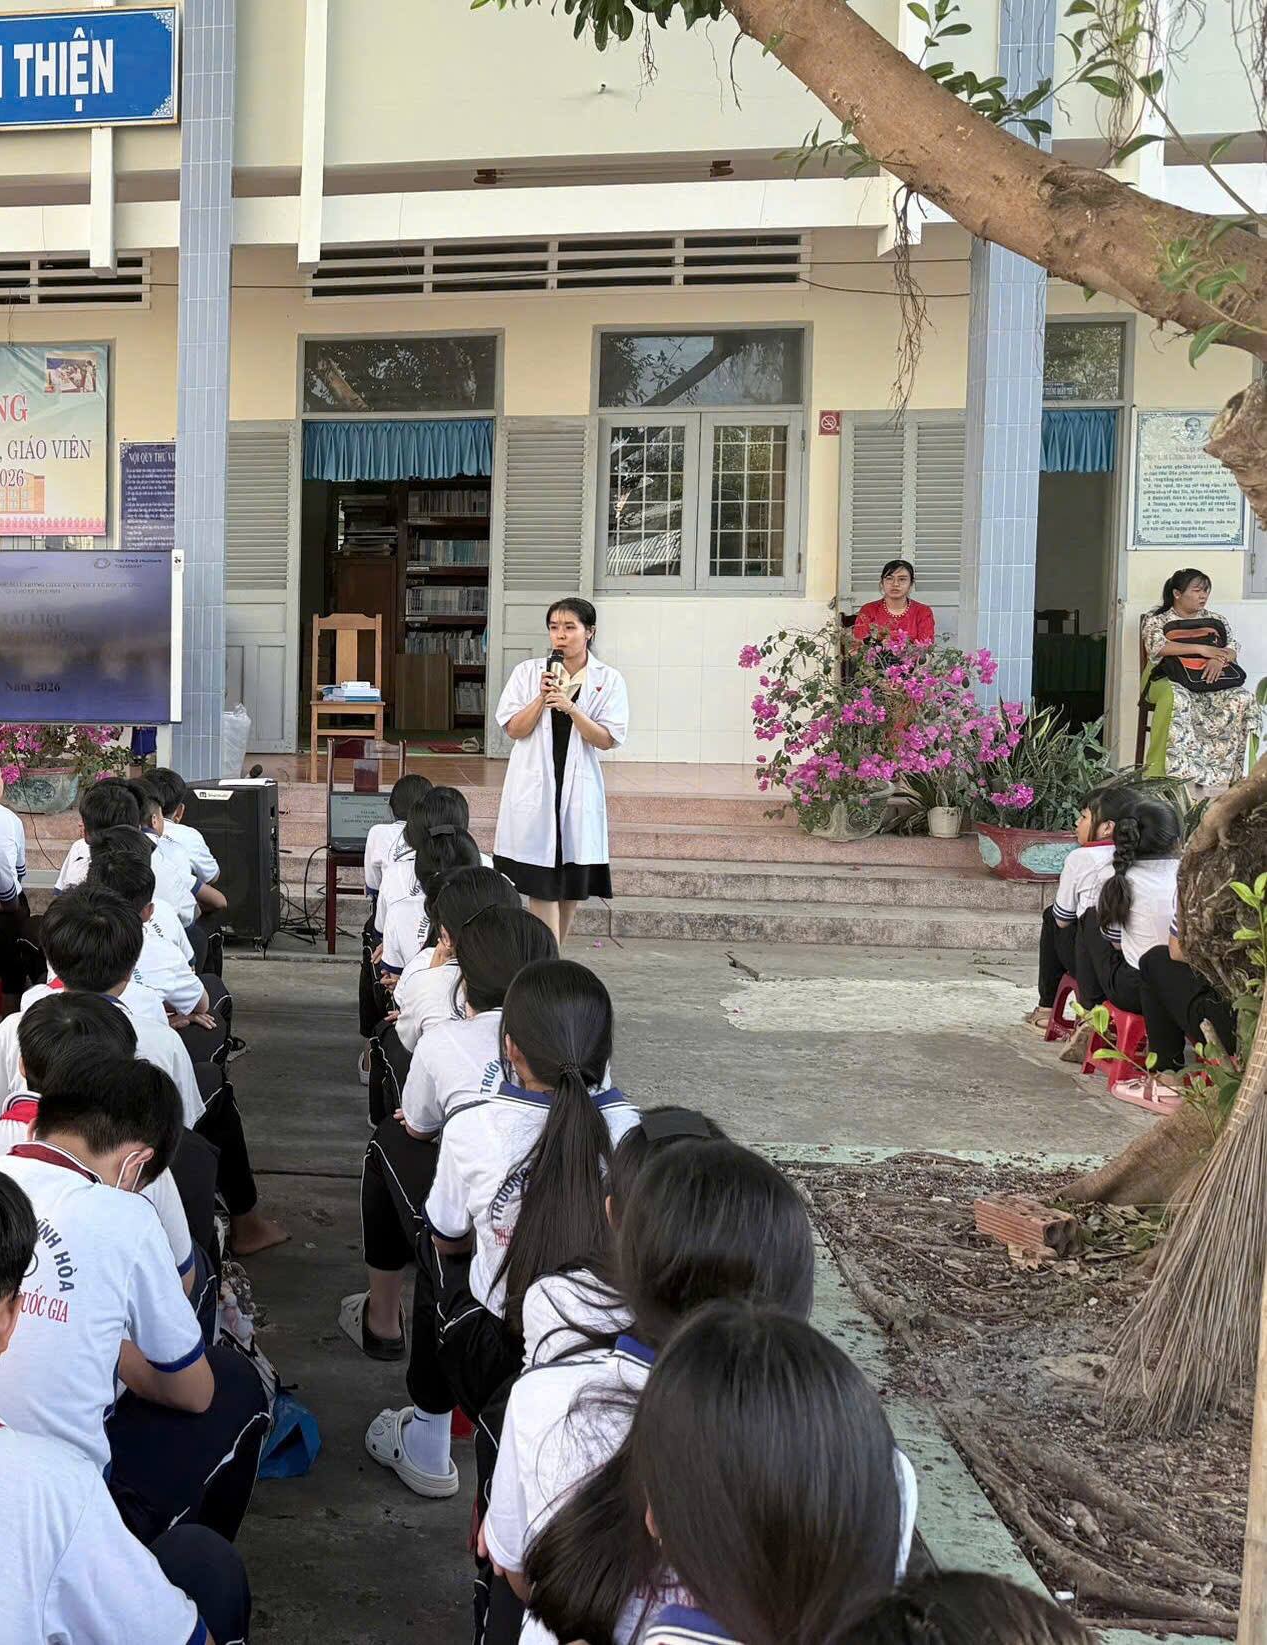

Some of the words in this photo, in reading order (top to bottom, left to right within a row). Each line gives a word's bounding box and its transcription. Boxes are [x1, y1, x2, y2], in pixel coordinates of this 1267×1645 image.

[13, 27, 115, 112] THIỆN
[7, 435, 47, 460] GIÁO
[51, 434, 91, 459] VIÊN
[34, 679, 61, 692] 2026
[54, 1251, 77, 1292] HÒA
[21, 1284, 47, 1317] UỐC
[48, 1298, 69, 1323] GIA
